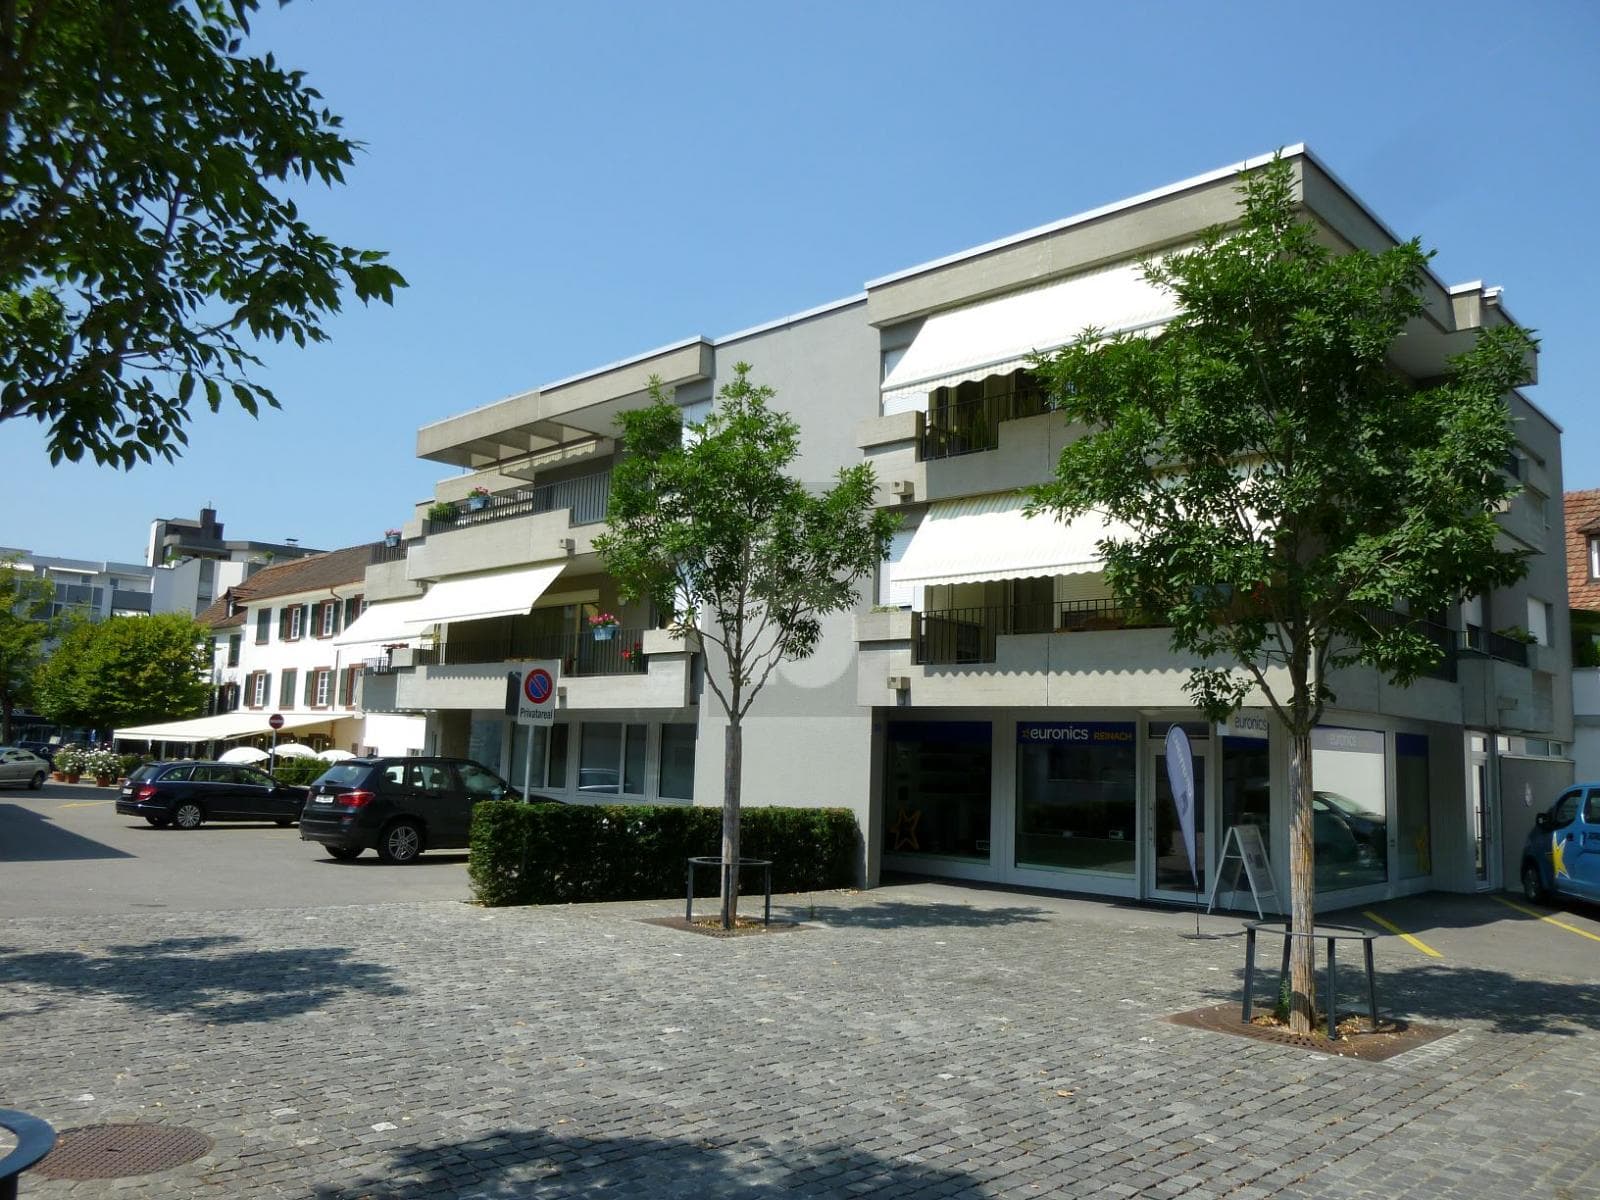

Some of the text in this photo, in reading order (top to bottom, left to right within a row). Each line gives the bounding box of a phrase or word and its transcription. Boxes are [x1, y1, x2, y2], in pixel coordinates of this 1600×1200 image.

[520, 707, 553, 720] Privatareal
[1235, 716, 1267, 731] euronics
[1030, 725, 1132, 742] euronics REINACH
